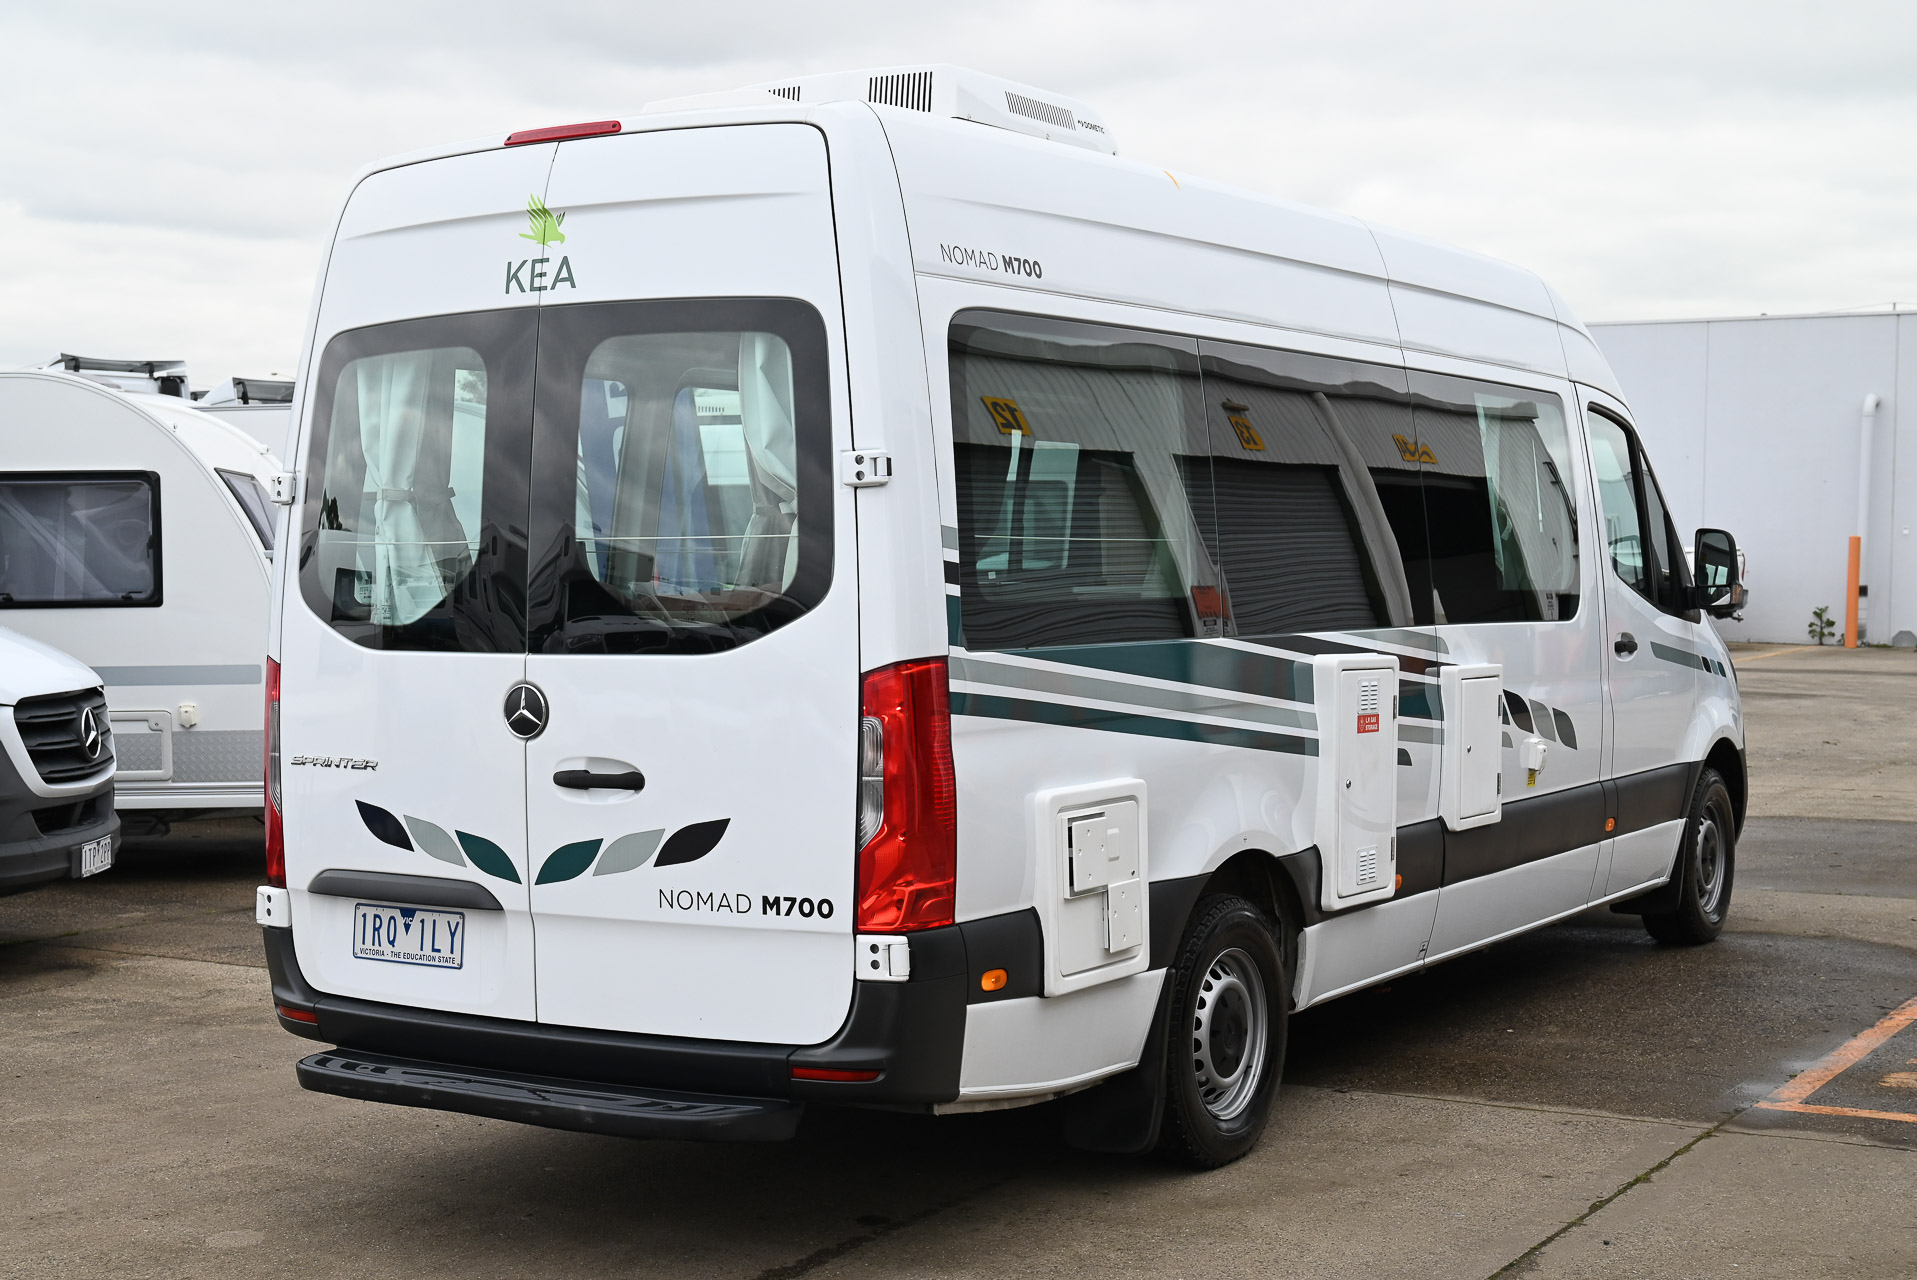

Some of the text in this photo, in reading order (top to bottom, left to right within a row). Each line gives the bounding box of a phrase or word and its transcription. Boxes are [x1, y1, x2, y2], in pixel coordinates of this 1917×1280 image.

[505, 255, 577, 294] KEA
[940, 243, 1043, 279] NOMAD M700
[291, 755, 379, 771] SPRINTER
[659, 888, 834, 919] NOMAD M700
[361, 912, 460, 955] 1RQ 1LY
[359, 947, 385, 957] VICTORIA
[390, 950, 402, 959] THE
[403, 952, 436, 963] EDUCATION
[437, 955, 456, 965] STATE
